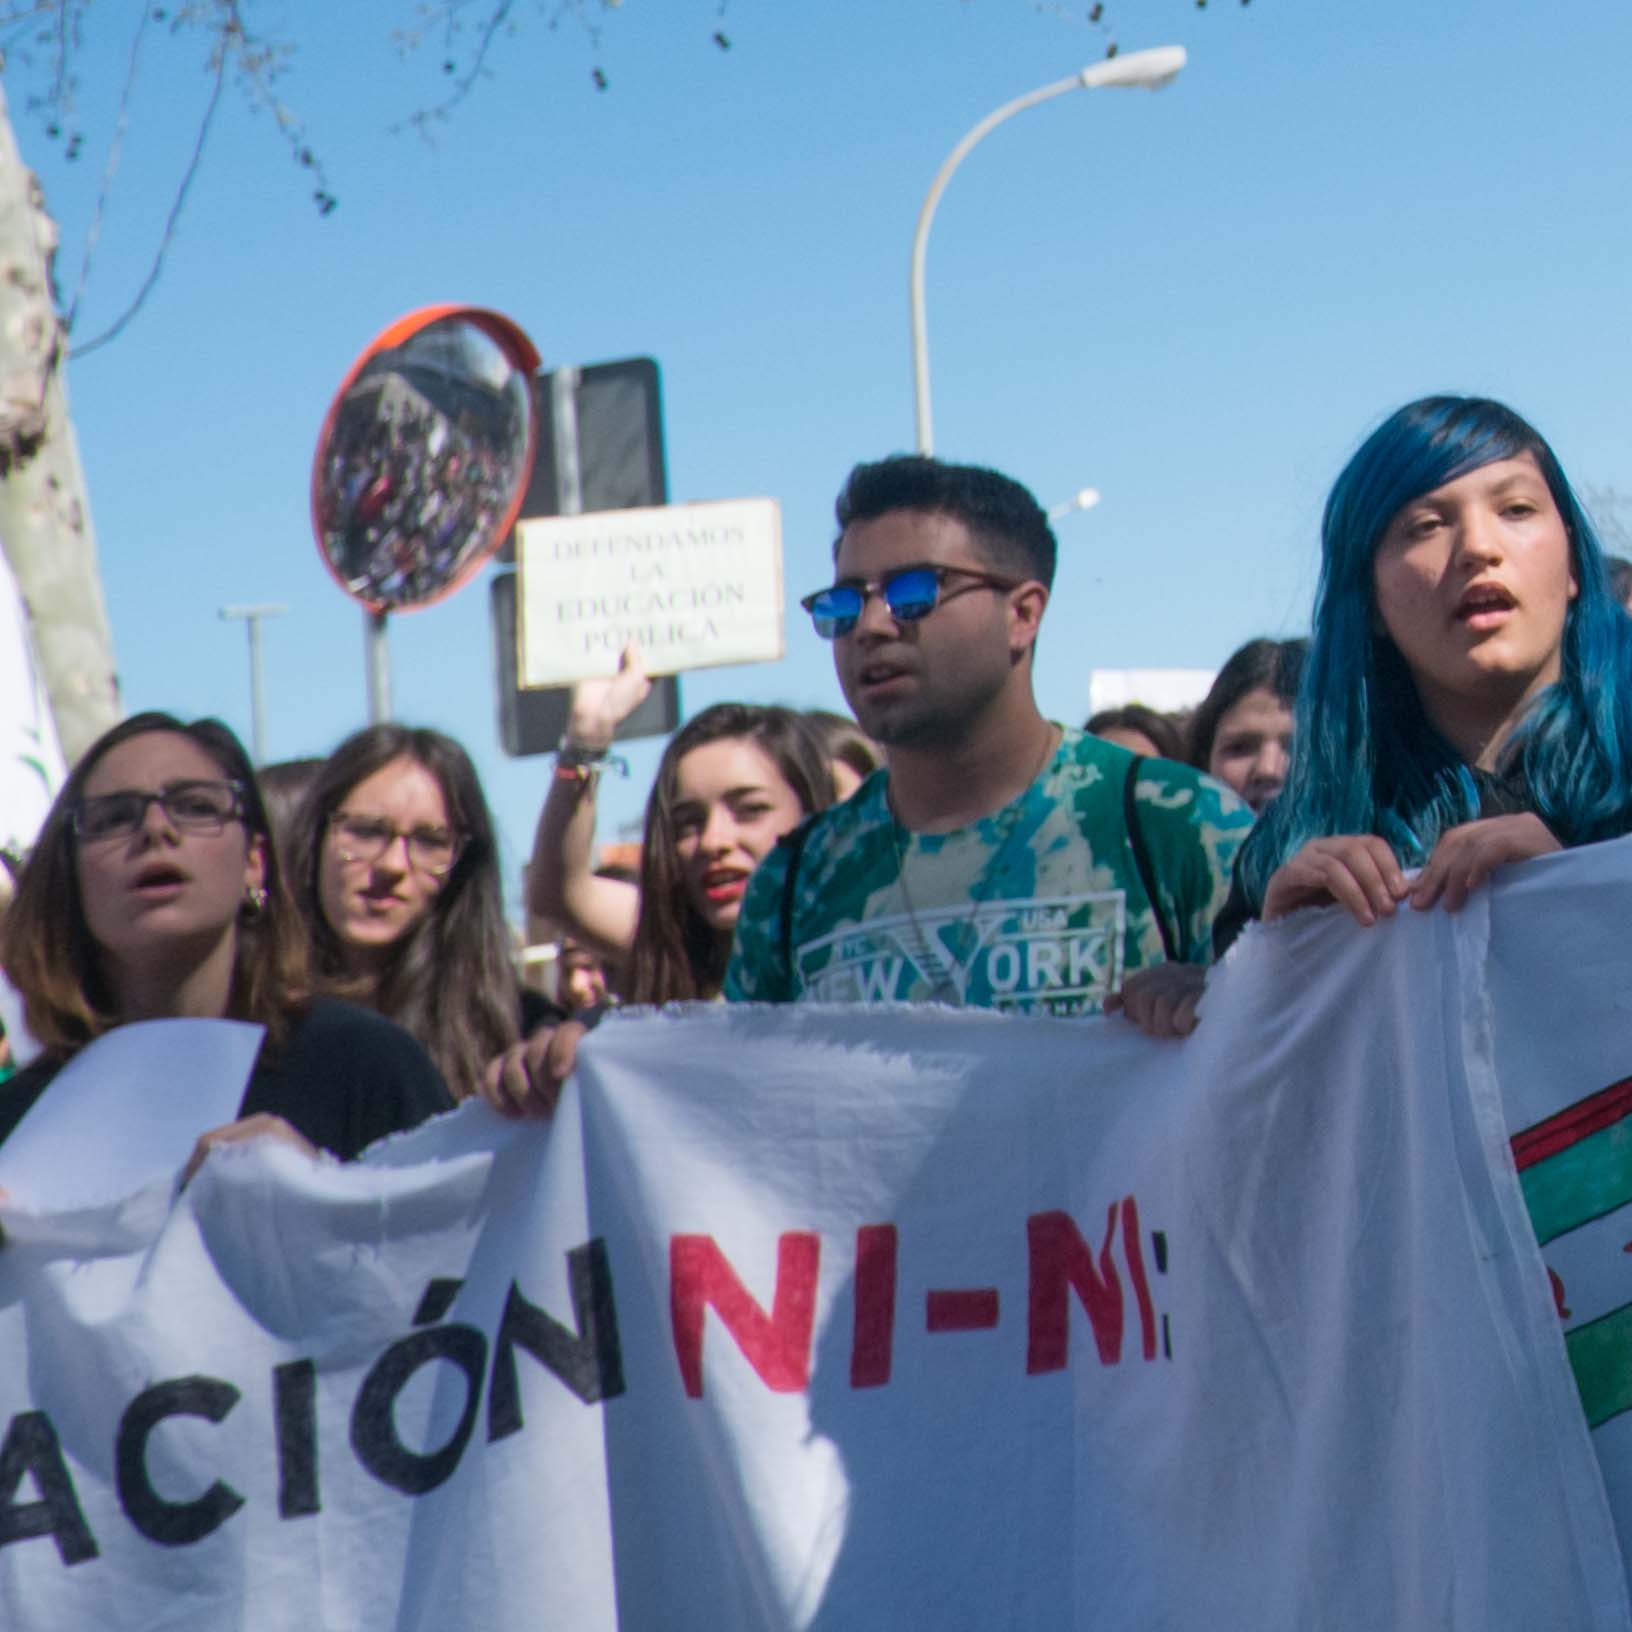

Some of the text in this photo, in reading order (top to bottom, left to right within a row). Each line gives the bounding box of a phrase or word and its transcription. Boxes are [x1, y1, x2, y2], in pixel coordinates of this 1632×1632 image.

[553, 527, 745, 561] DEFENDAMOS
[629, 562, 666, 583] LA
[556, 577, 745, 623] EDUCACIÓN
[1021, 909, 1069, 930] USA
[884, 913, 1105, 1006] YORK
[0, 1234, 626, 1567] ACIÓN
